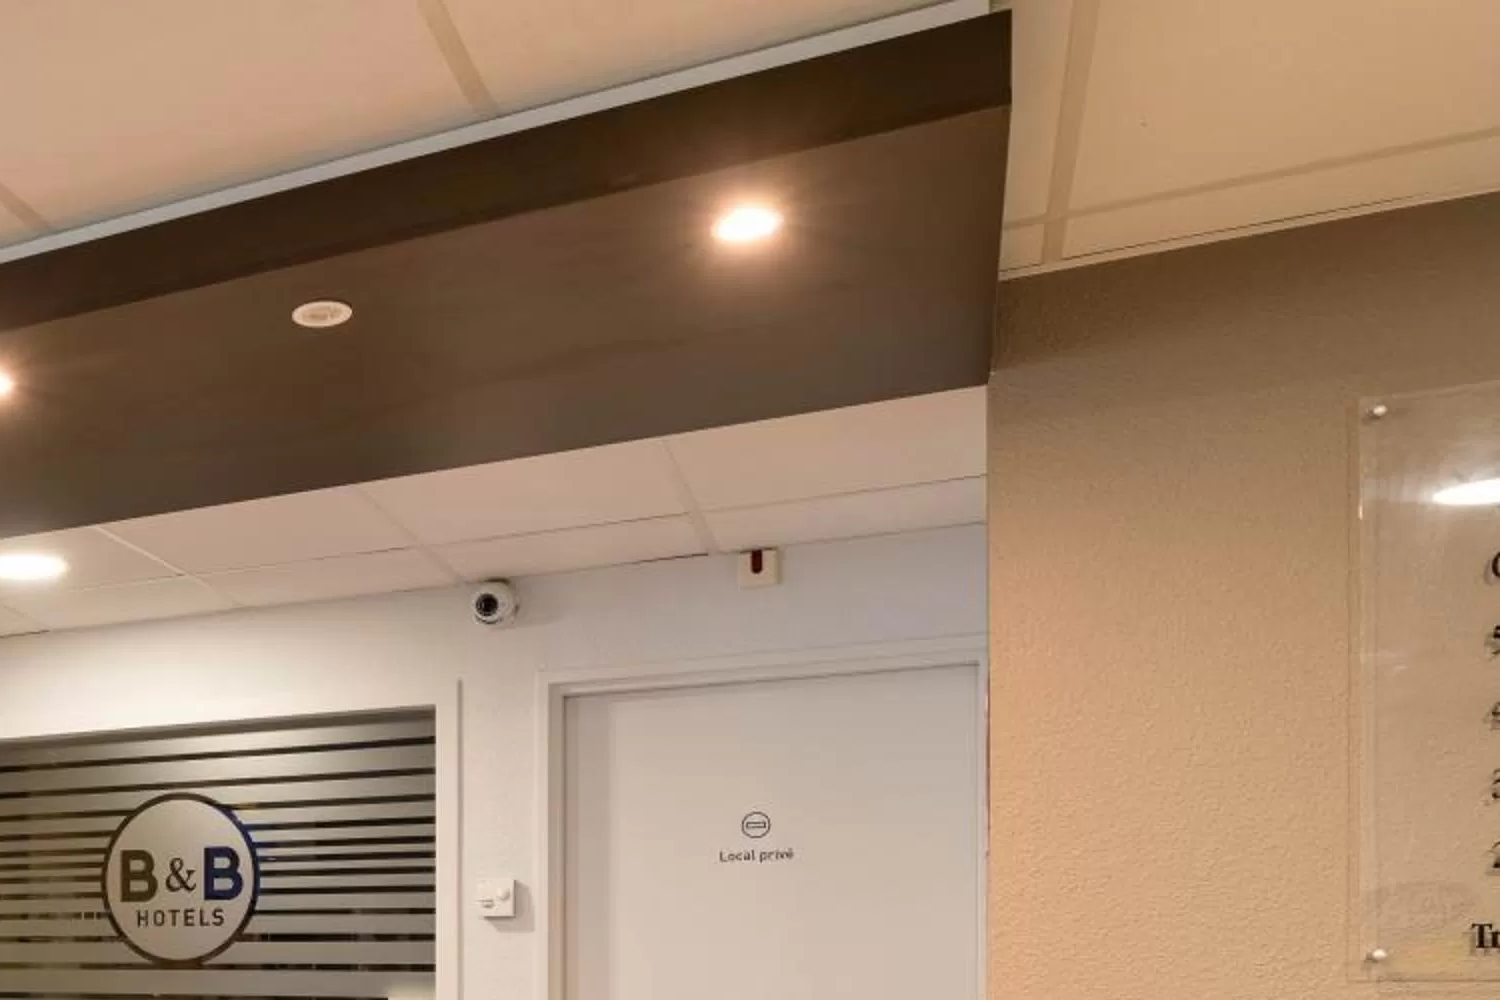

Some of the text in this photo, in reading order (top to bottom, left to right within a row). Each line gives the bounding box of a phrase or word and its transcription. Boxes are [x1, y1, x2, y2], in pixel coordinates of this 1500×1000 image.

[719, 849, 755, 863] Local
[120, 847, 243, 903] B&B
[136, 908, 225, 928] HOTELS
